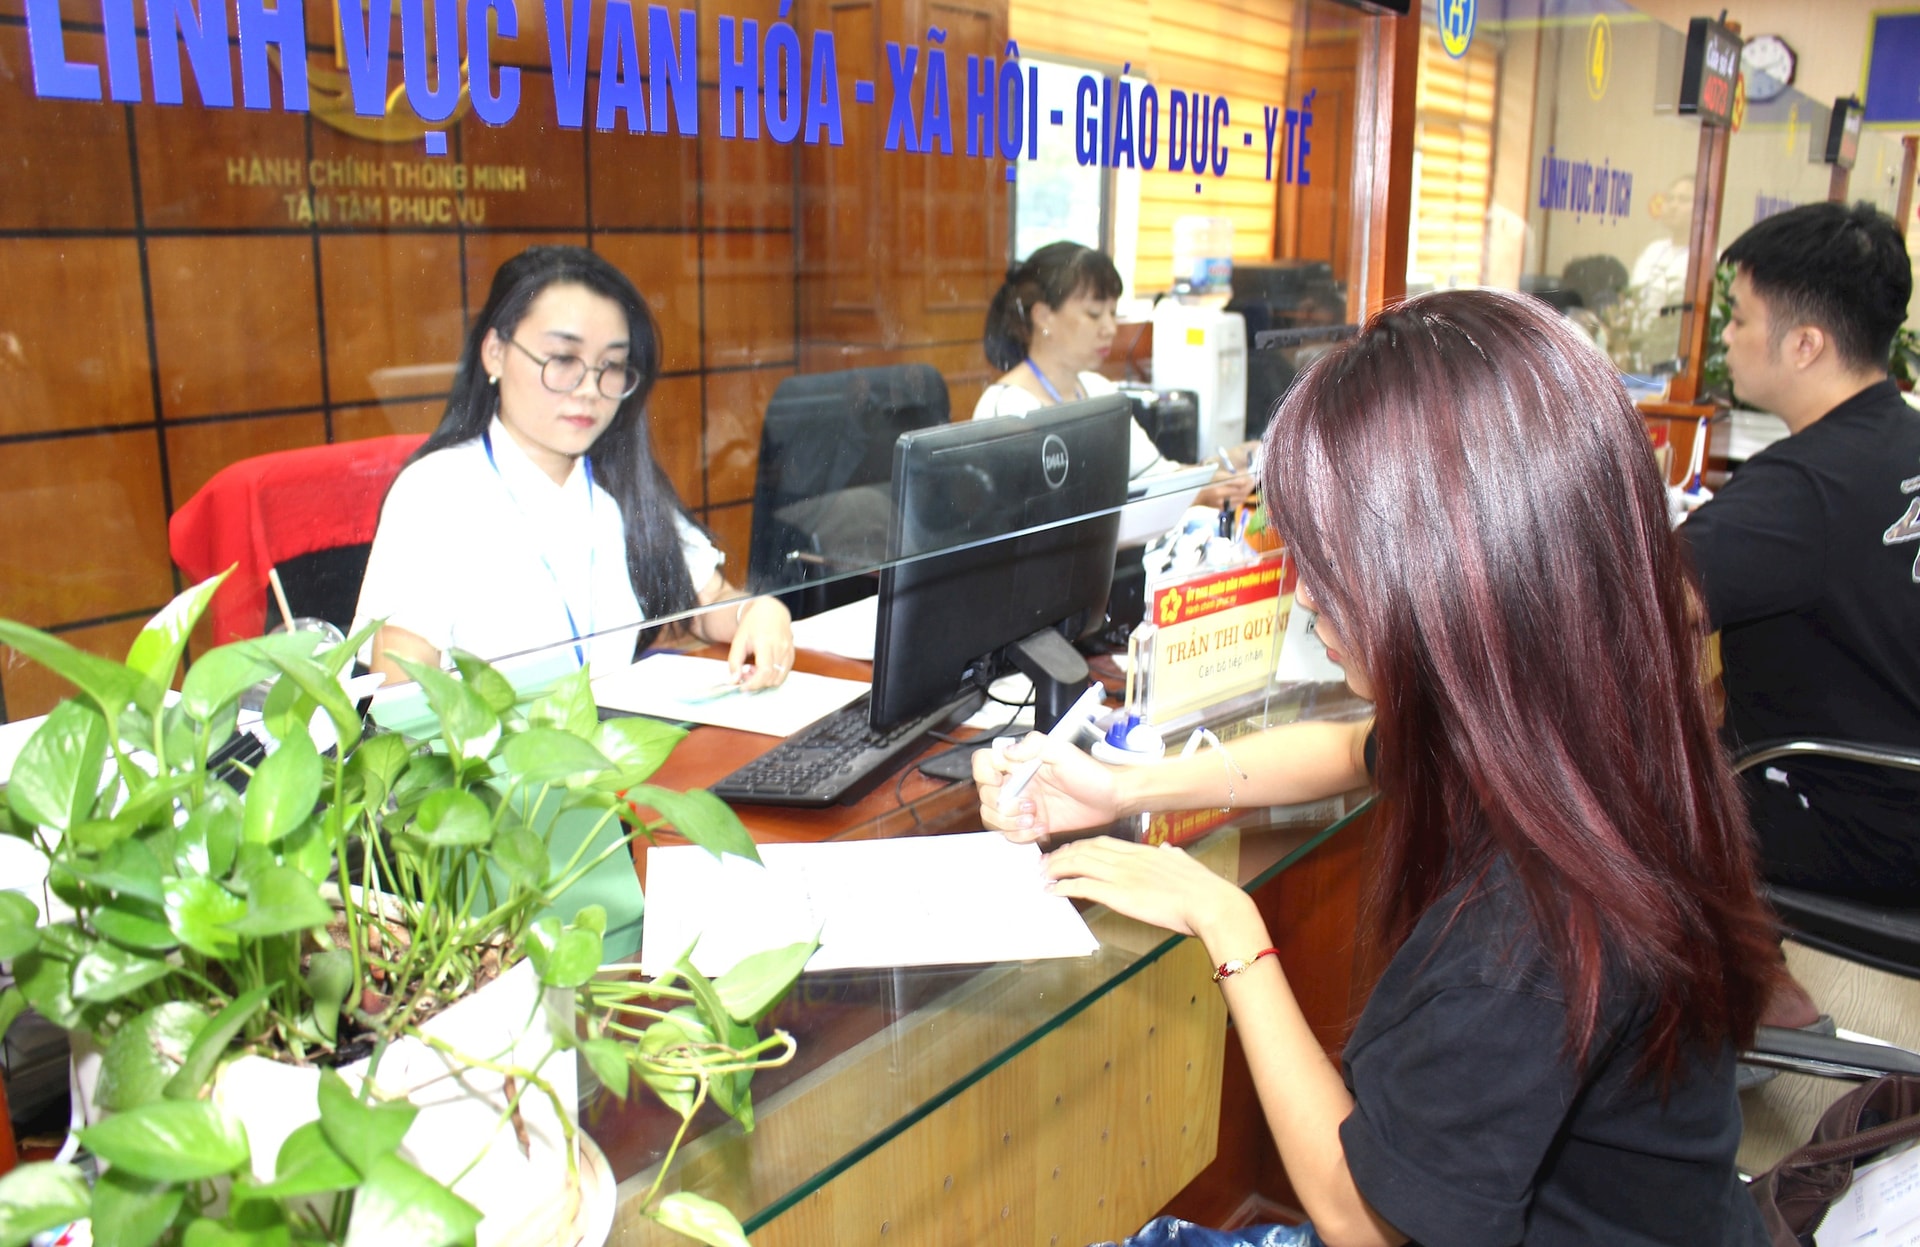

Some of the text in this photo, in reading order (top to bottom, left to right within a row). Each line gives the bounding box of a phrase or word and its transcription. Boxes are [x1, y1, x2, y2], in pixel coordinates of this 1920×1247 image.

[718, 0, 844, 145] HÓA
[884, 25, 953, 155] XÃ
[966, 38, 1038, 182] HỘI
[1075, 62, 1159, 171] GIÁO
[1168, 89, 1230, 194] DỤC
[1264, 105, 1279, 181] Y
[1285, 87, 1317, 185] TẾ
[473, 164, 527, 191] MINH
